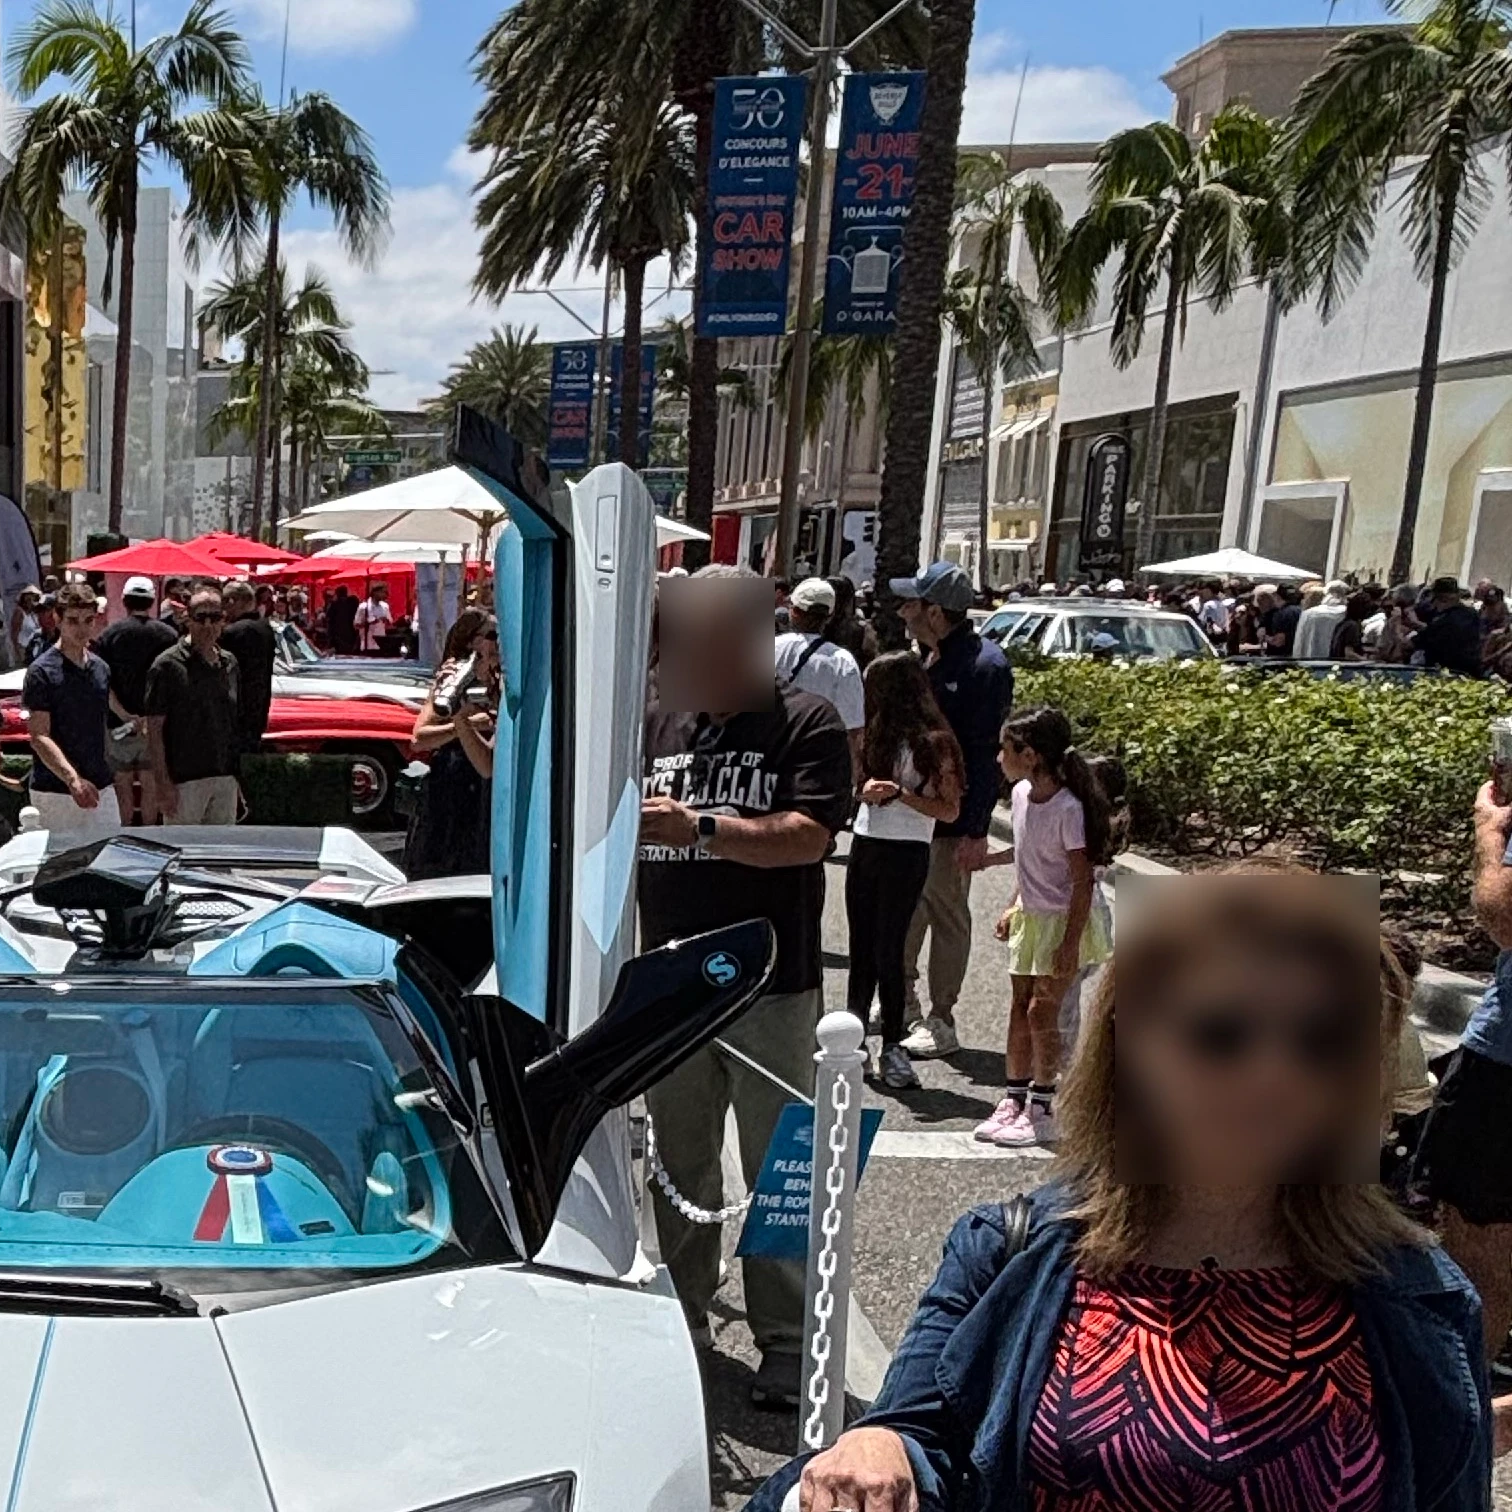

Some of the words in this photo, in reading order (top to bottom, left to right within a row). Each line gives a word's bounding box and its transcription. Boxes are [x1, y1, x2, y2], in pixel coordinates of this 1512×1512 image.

[729, 87, 785, 130] 50
[724, 137, 787, 150] CONCOURS
[845, 132, 921, 160] JUNE
[713, 210, 784, 243] CAR
[710, 247, 783, 272] SHOW
[836, 310, 896, 321] O'GARA
[741, 751, 764, 768] OF
[757, 1194, 782, 1207] THE
